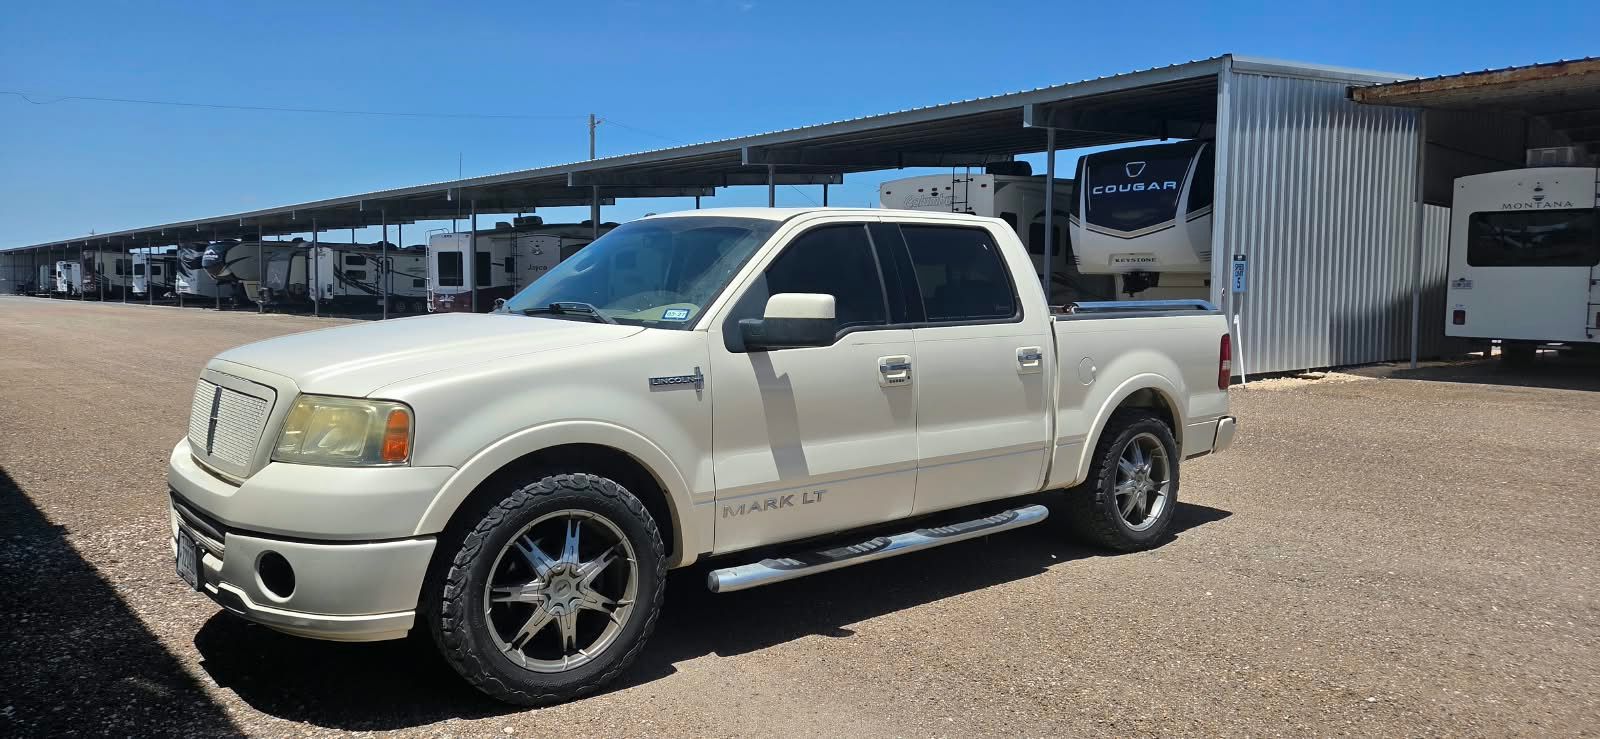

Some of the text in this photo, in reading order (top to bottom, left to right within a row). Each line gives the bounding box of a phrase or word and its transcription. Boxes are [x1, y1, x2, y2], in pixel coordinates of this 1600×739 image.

[1092, 181, 1177, 195] COUGAR
[1502, 201, 1574, 210] MONTANA
[527, 263, 548, 272] Jayco
[1236, 277, 1241, 288] 5
[652, 376, 697, 385] LINCOLN
[722, 490, 827, 518] MARK LT
